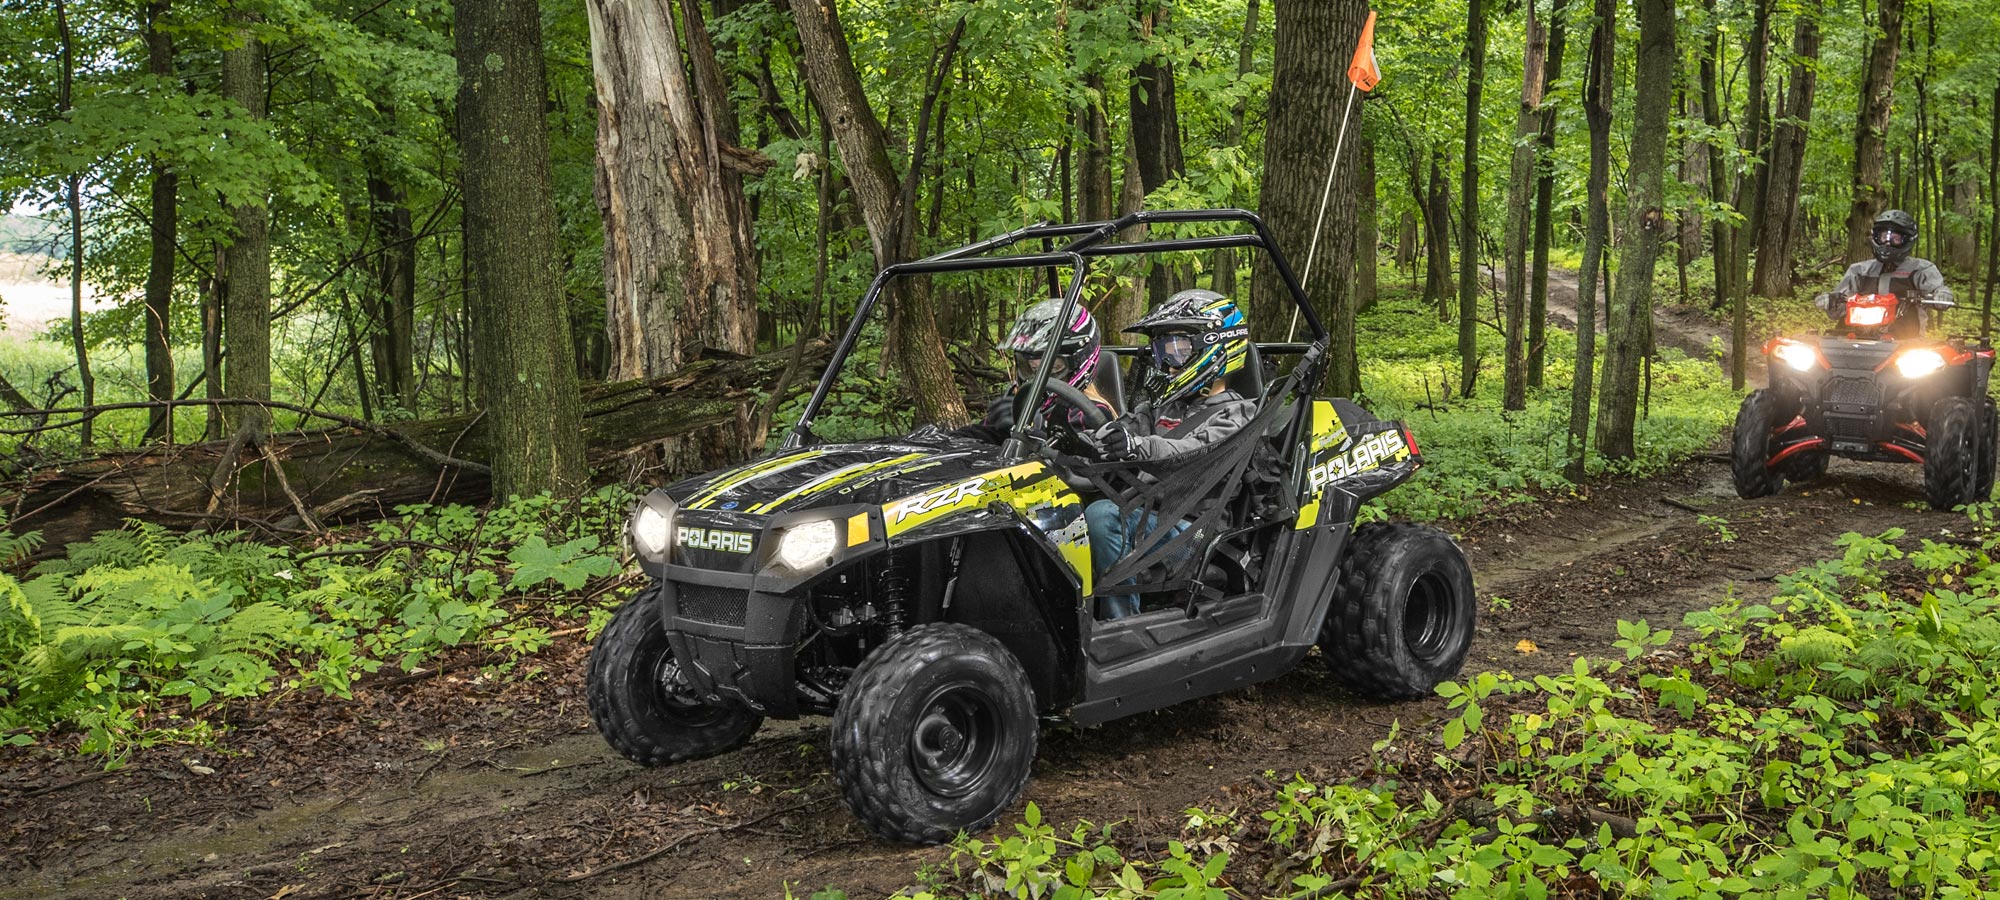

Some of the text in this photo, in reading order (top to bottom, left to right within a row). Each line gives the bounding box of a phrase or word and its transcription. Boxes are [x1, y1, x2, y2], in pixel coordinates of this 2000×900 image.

[1308, 429, 1404, 495] POLARIS
[896, 477, 987, 525] RZR
[676, 526, 753, 554] POLARIS
